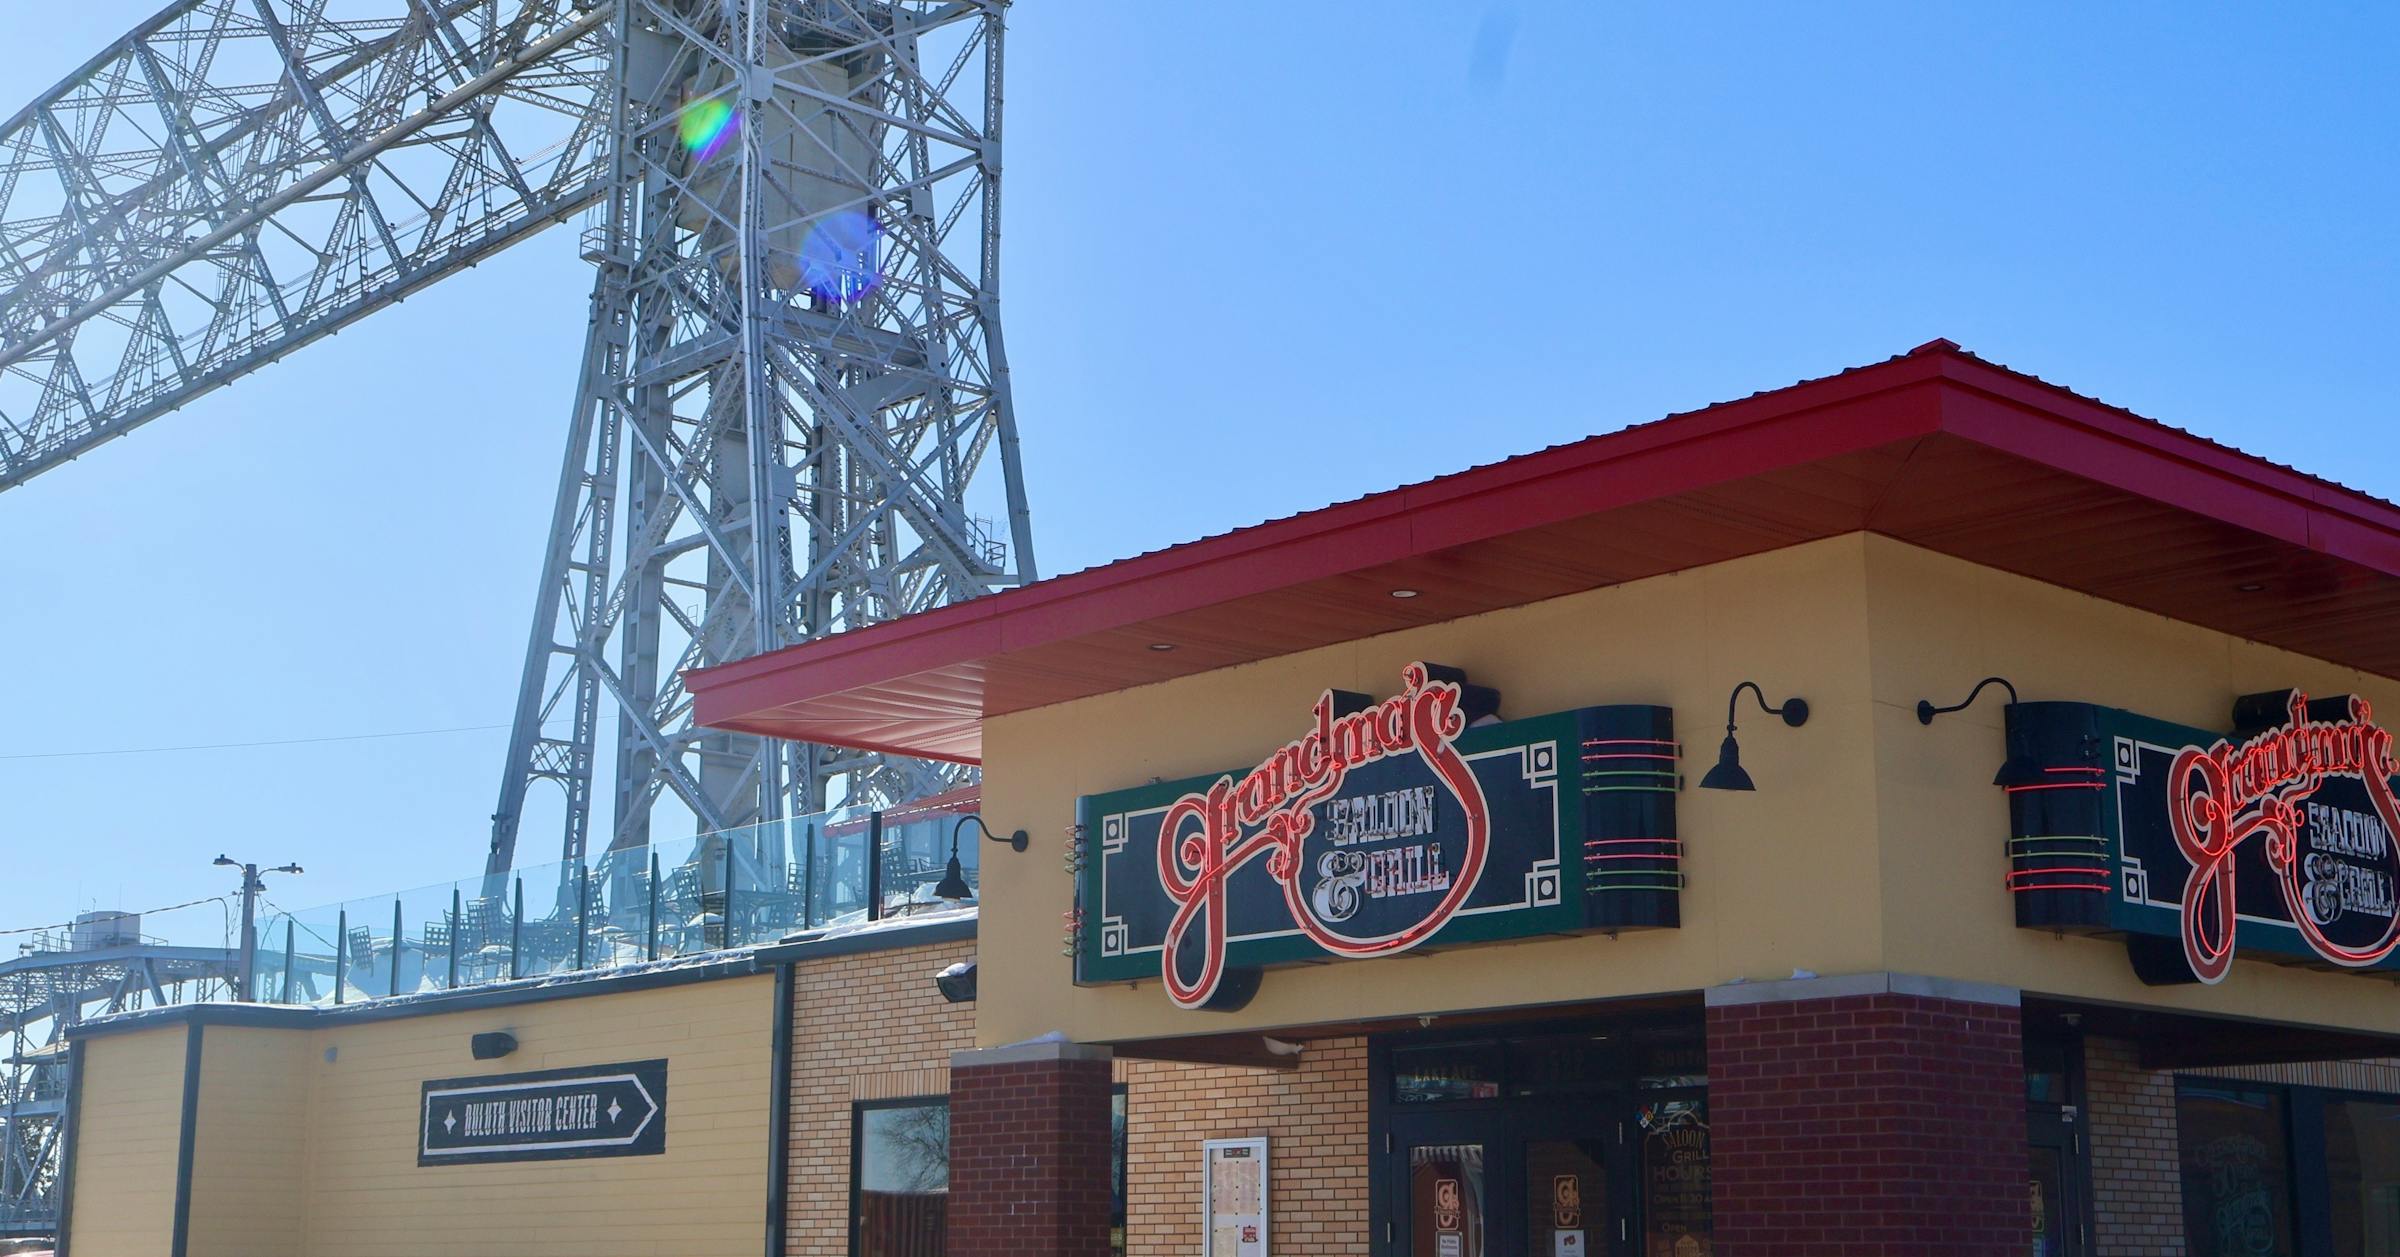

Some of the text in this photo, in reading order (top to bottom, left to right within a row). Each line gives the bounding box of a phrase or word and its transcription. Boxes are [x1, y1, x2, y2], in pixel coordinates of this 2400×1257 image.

[1325, 785, 1434, 846] SALOON
[2308, 802, 2387, 861] SALOON
[1312, 842, 1449, 922] & GRILL
[2302, 852, 2396, 925] & GRILL
[464, 1093, 599, 1137] DULUTH VISITOR CENTER
[1662, 1128, 1706, 1151] SALOON
[1672, 1149, 1710, 1164] GRILL
